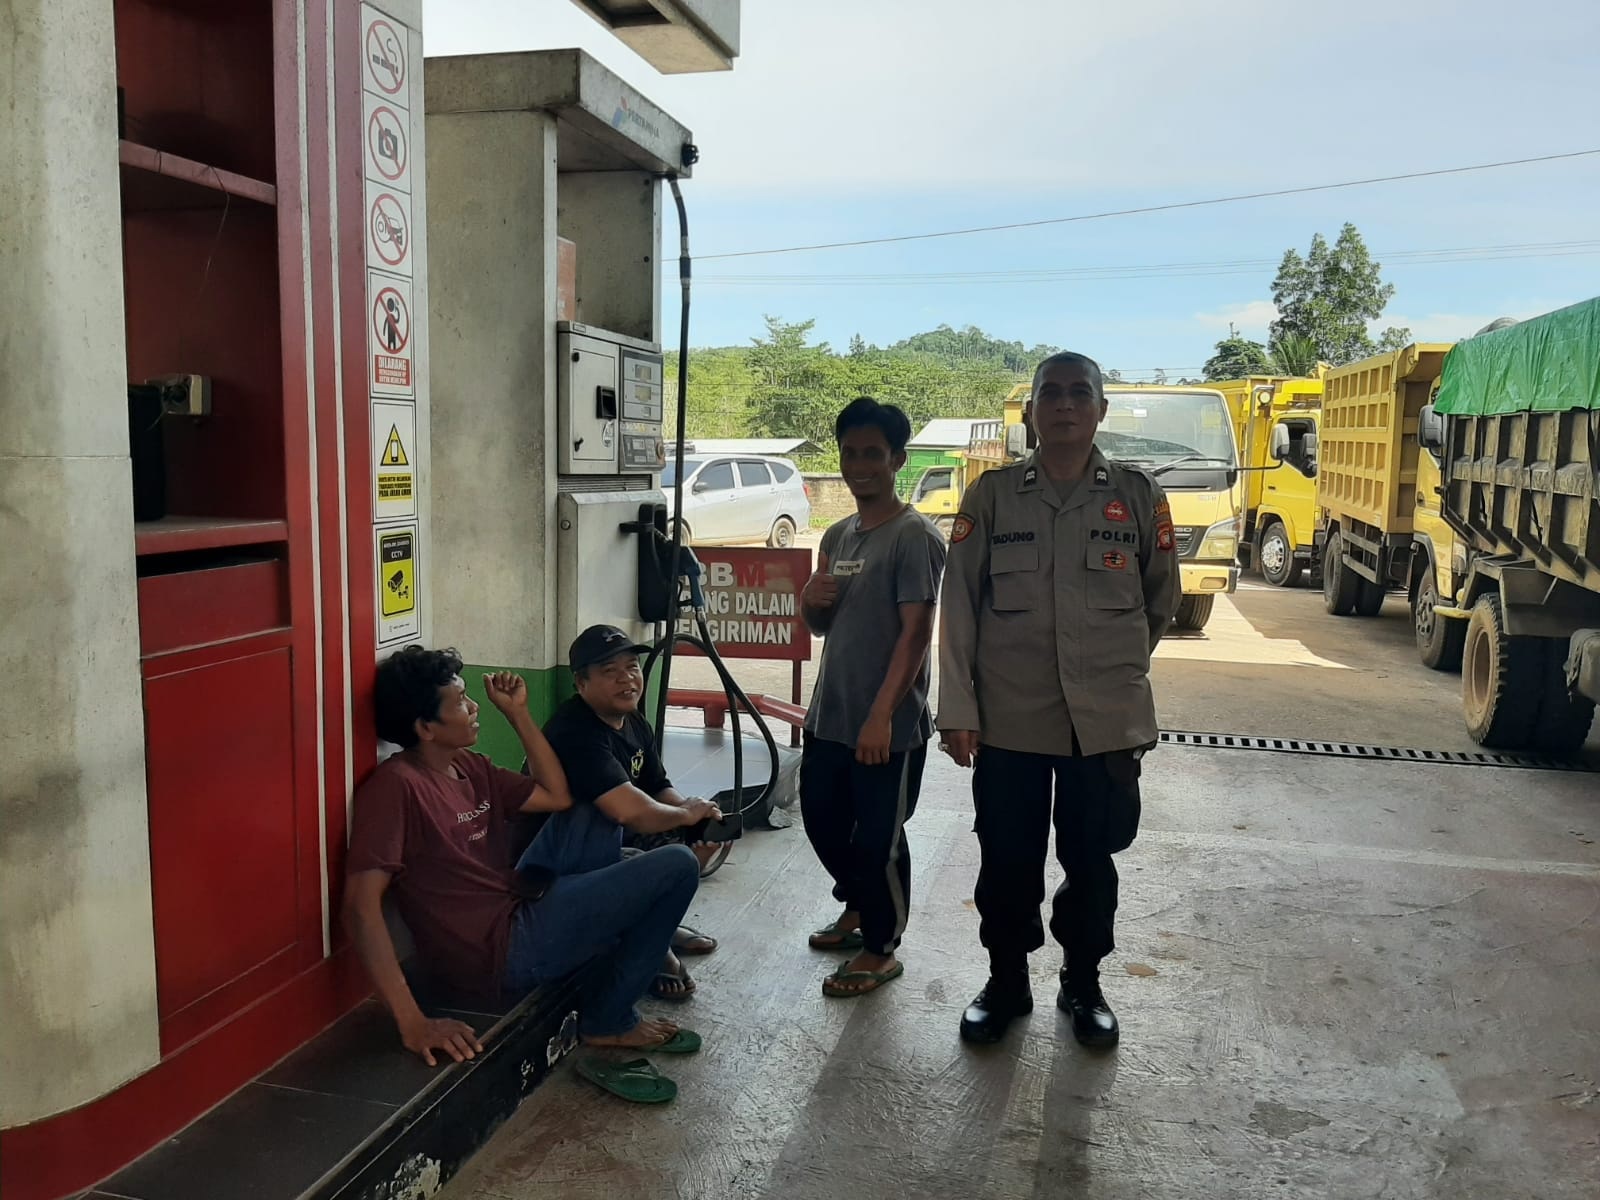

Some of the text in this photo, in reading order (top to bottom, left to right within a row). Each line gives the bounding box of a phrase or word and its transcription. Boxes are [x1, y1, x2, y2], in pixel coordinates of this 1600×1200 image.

[378, 356, 407, 370] DILARANG
[1090, 529, 1136, 544] POLRI
[391, 550, 403, 559] CCTV
[735, 592, 795, 616] DALAM
[673, 618, 792, 645] ENGIRIMAN
